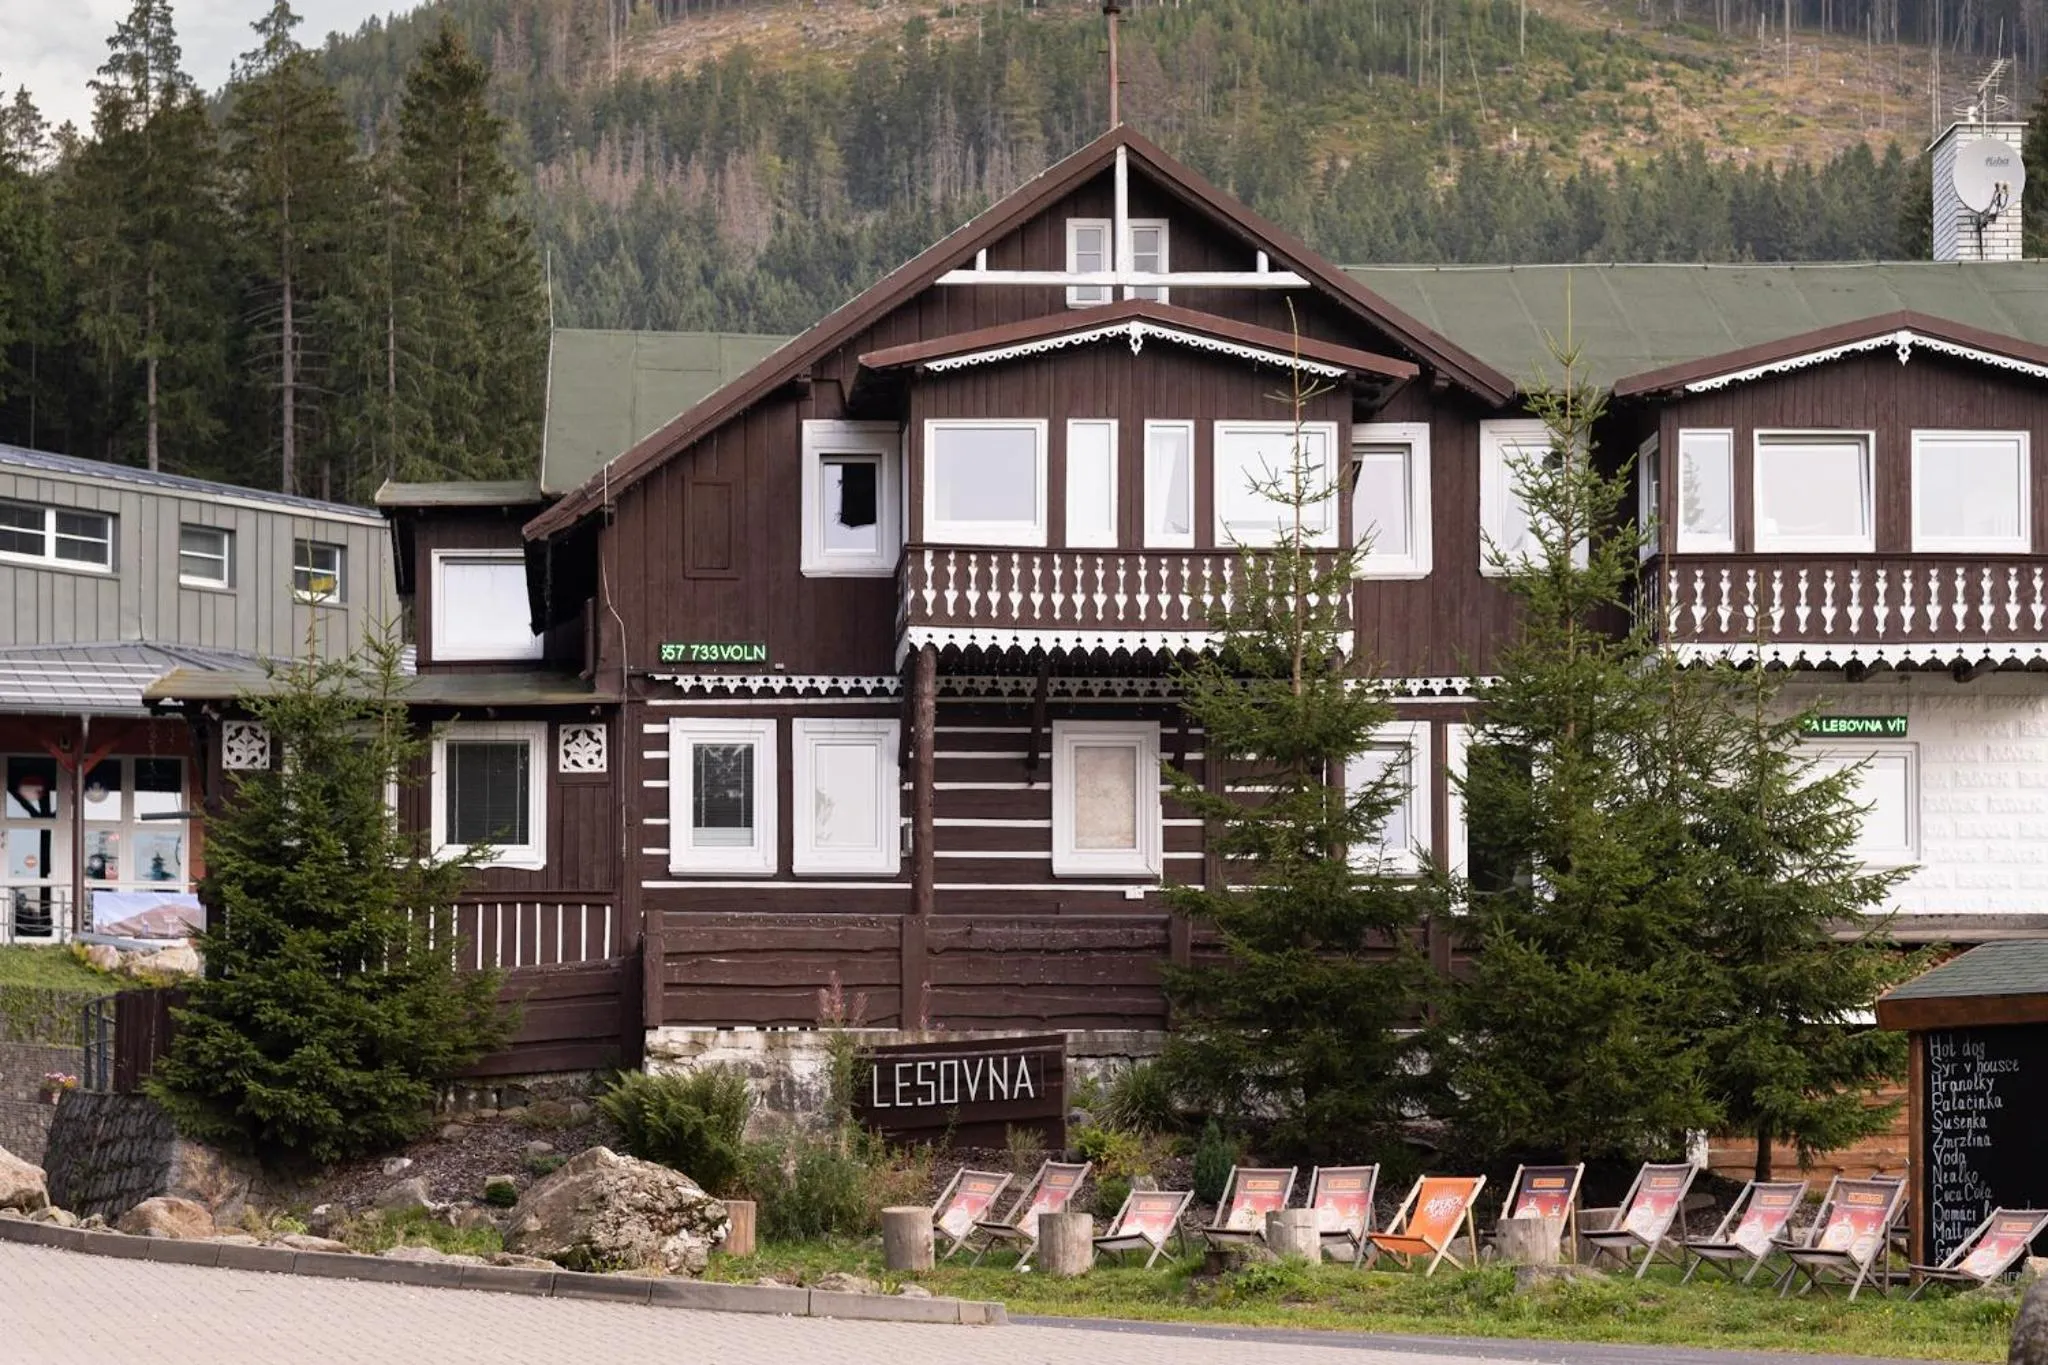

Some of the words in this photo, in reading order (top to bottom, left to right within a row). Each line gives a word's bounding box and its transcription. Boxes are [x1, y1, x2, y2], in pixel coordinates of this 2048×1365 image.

[1930, 1033, 1957, 1057] Hot
[1962, 1036, 1986, 1060] dog
[1964, 1062, 1972, 1073] v
[873, 1055, 1035, 1108] LESOVNA
[1932, 1073, 1994, 1097] Hranolky
[1932, 1109, 1988, 1130] Sušenka
[1932, 1129, 1992, 1148] Zmrzlina
[1932, 1147, 1966, 1166] Voda
[1932, 1164, 1979, 1184] Nealko
